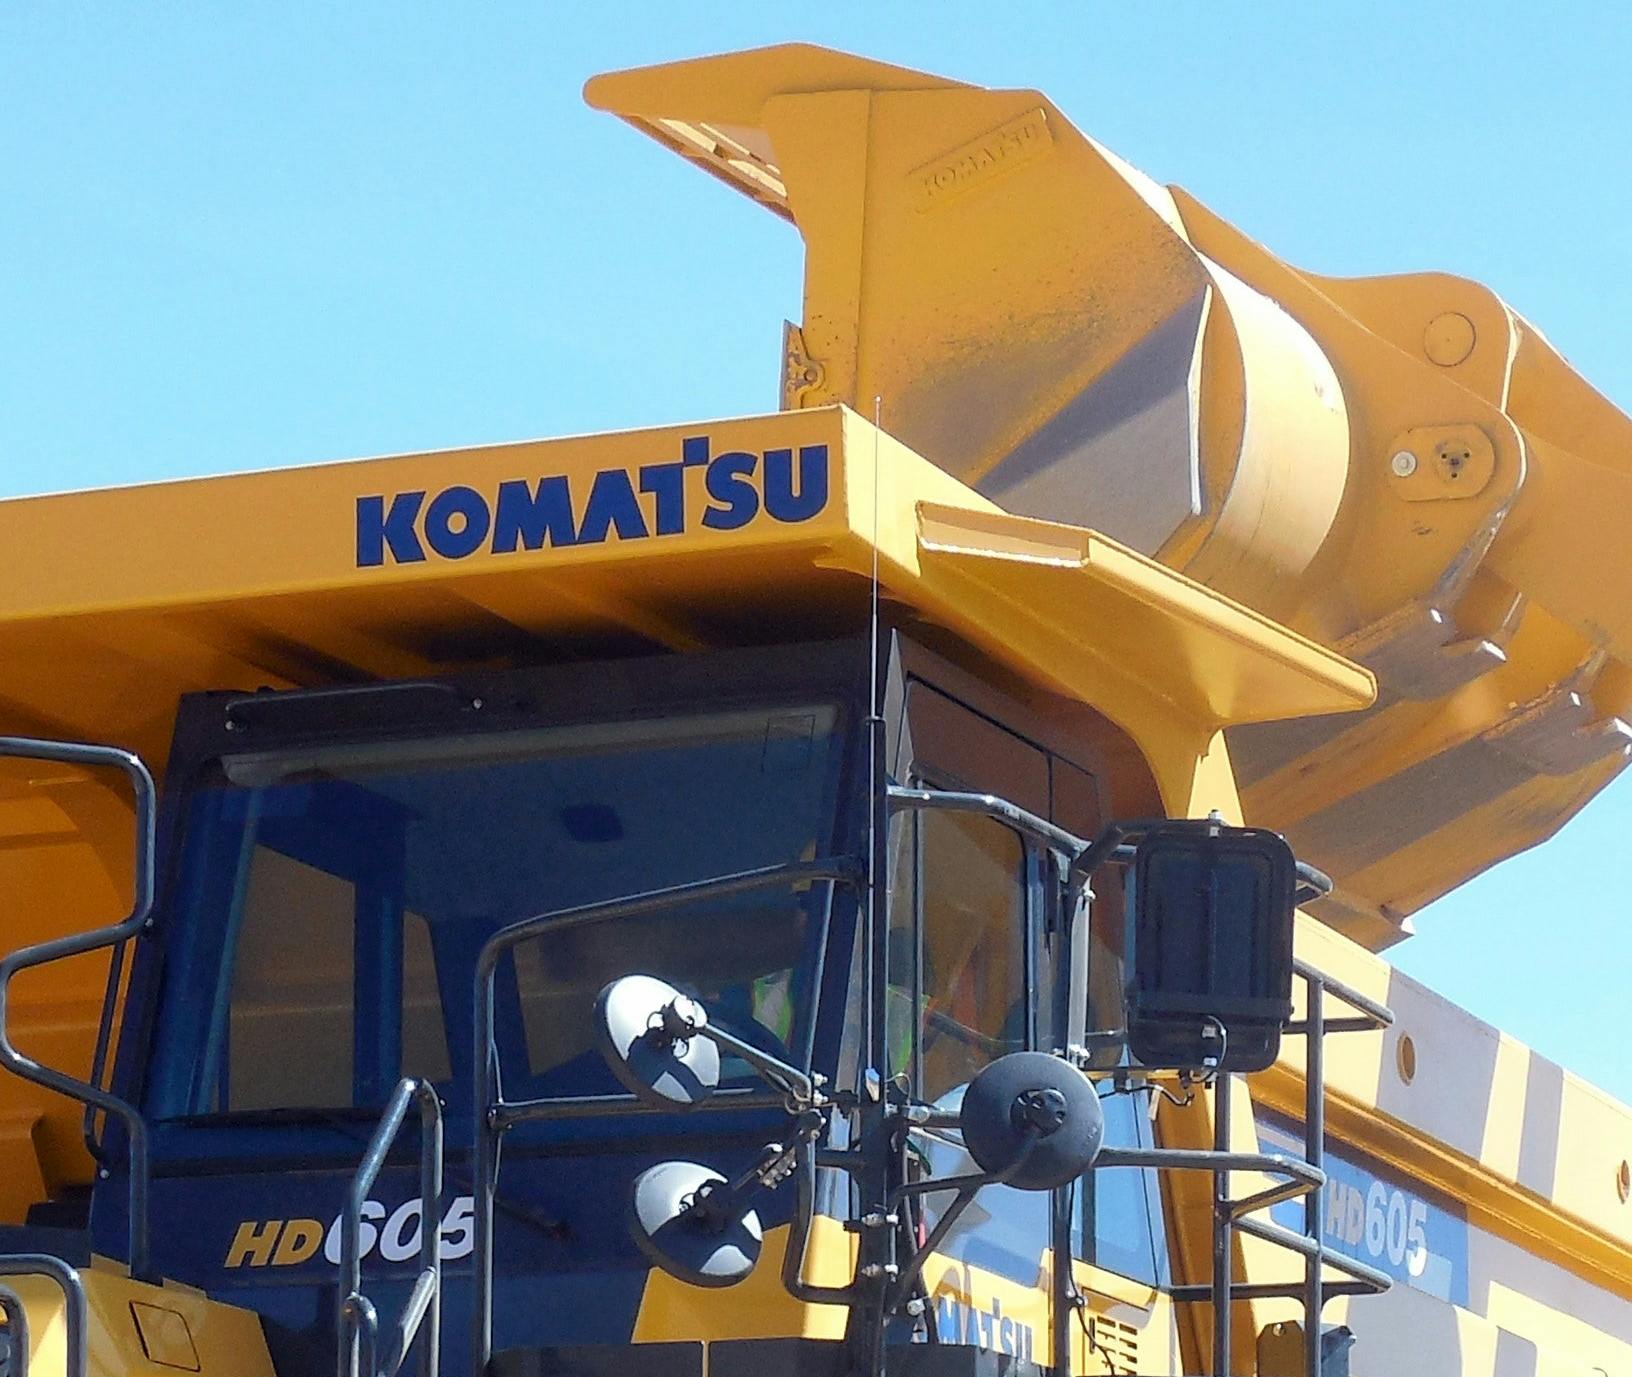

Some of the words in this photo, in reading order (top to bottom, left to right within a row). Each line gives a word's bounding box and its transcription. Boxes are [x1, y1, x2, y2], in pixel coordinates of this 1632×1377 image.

[355, 436, 829, 567] KOMATSU
[223, 1196, 475, 1268] HD605
[1325, 1179, 1428, 1277] HD605
